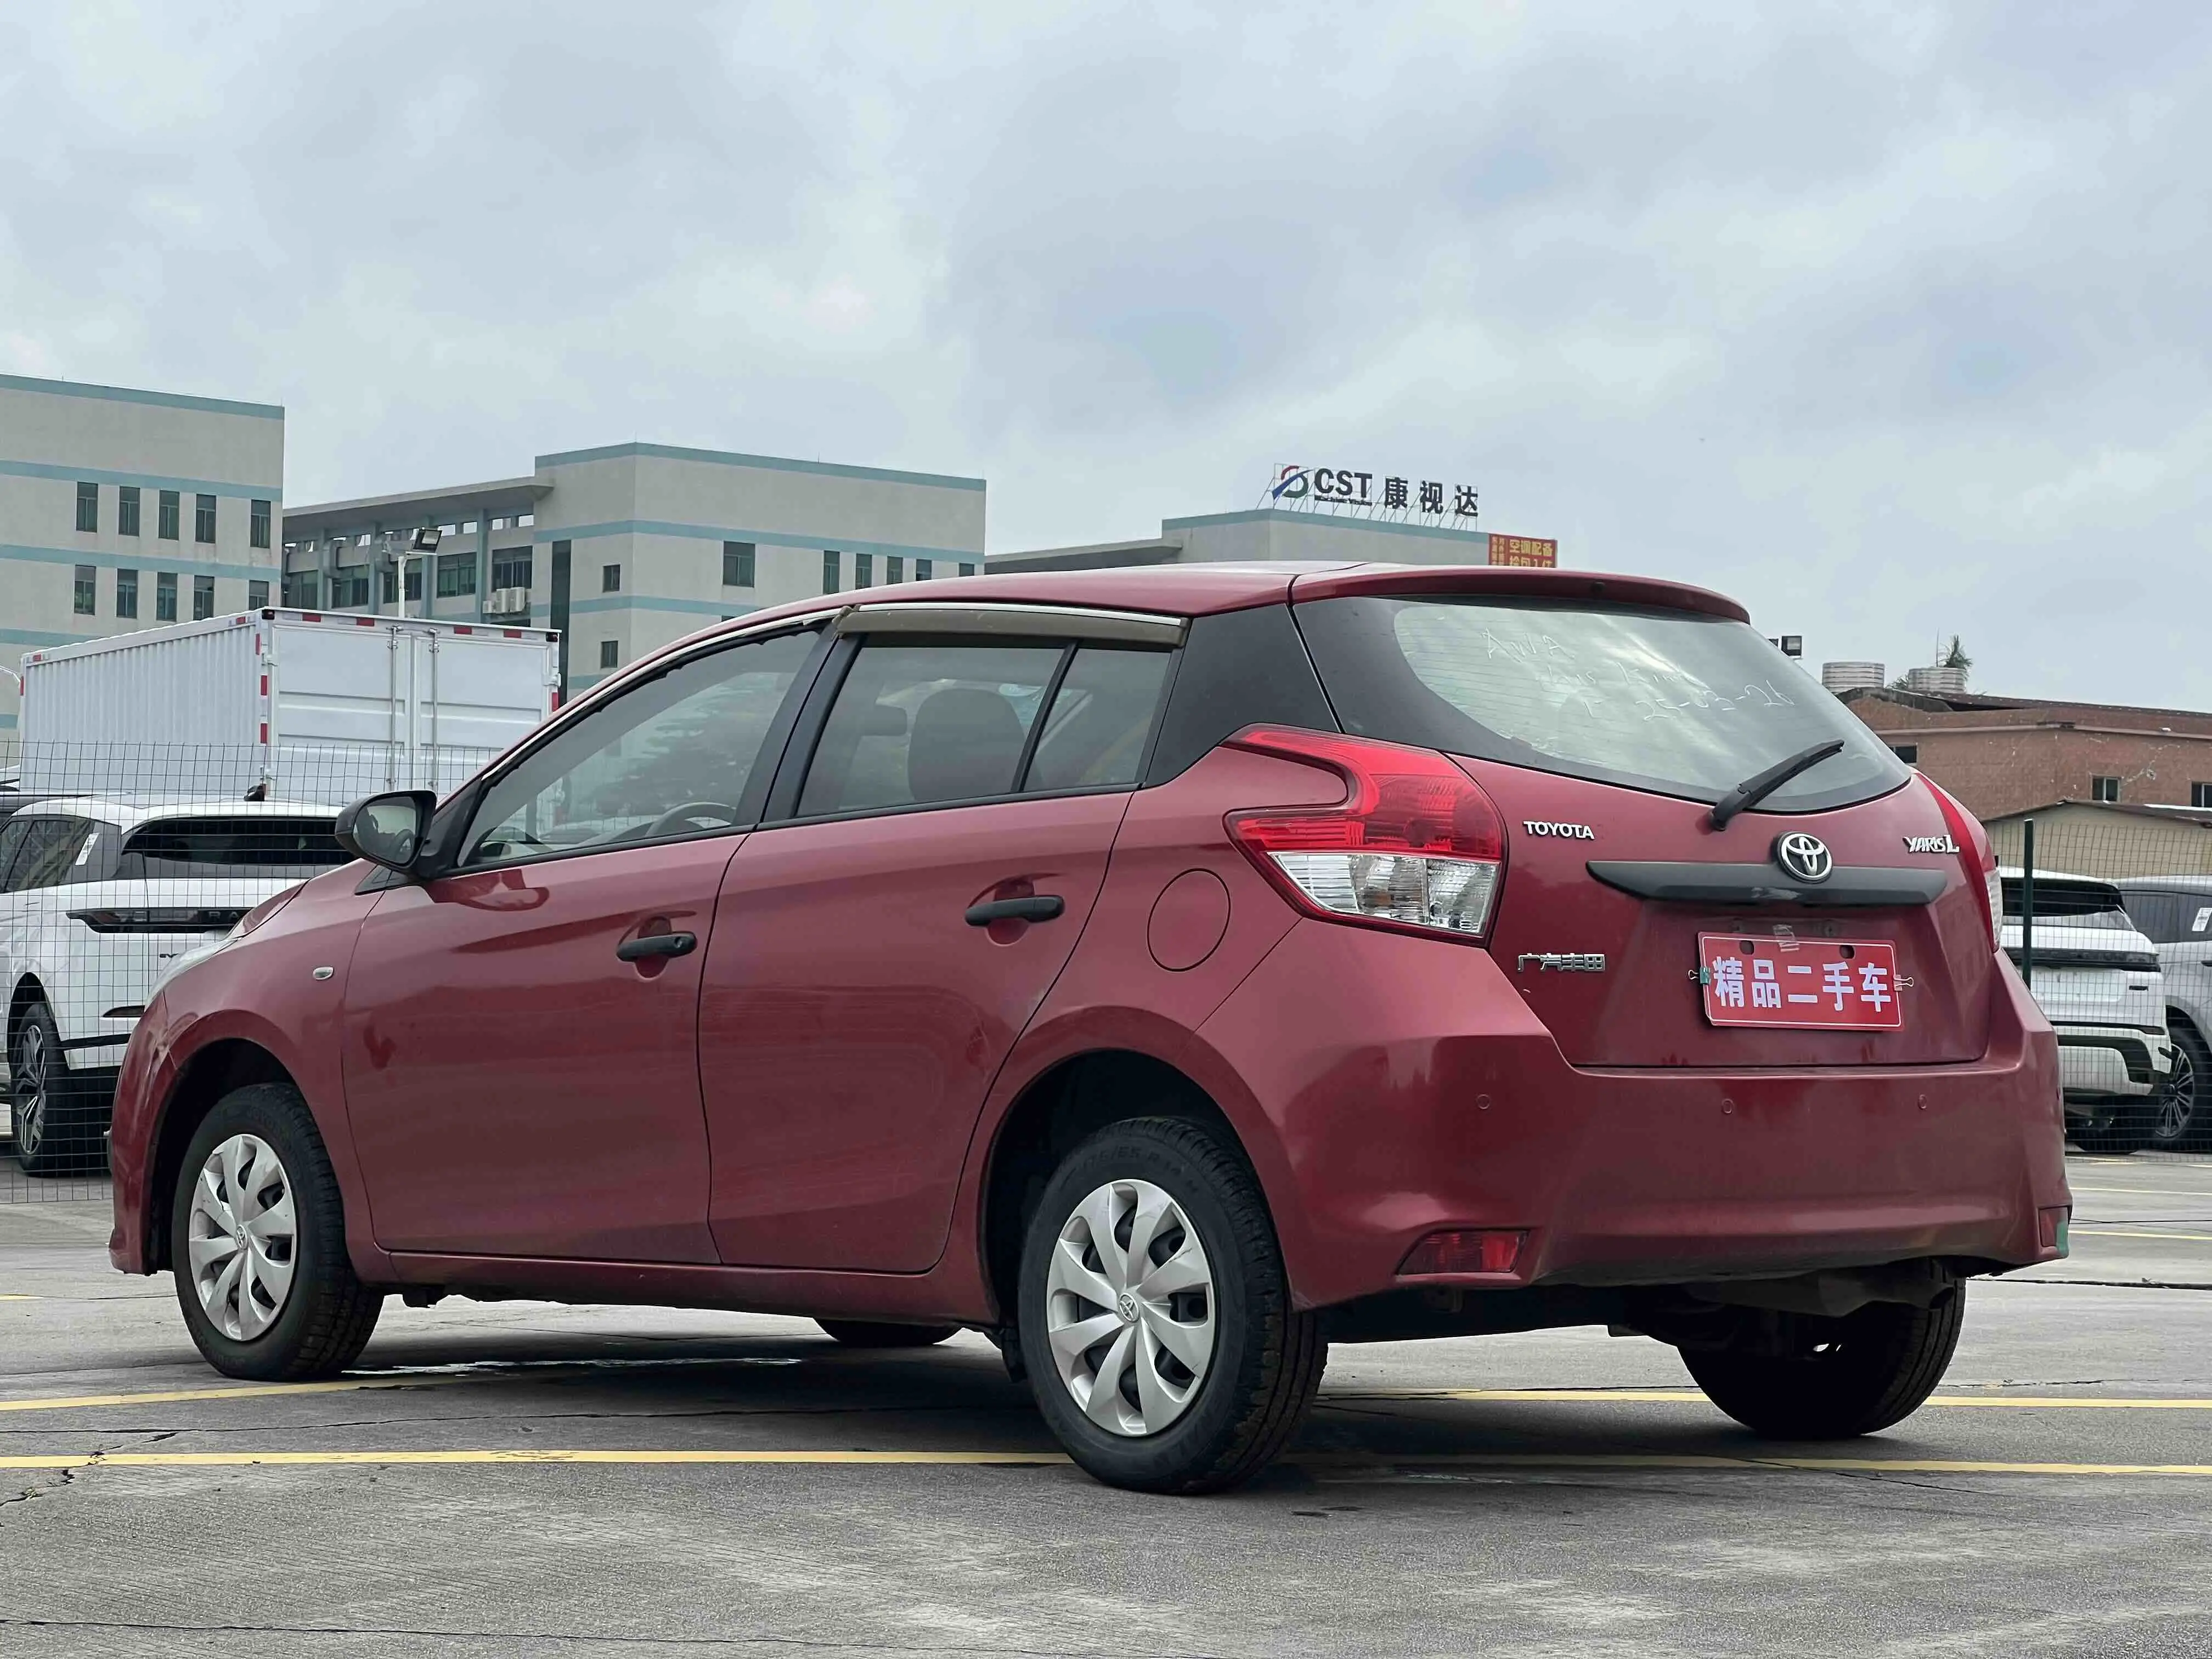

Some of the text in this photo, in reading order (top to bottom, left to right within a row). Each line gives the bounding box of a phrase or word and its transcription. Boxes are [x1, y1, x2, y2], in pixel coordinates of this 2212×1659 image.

[1314, 468, 1372, 498] CST
[1385, 477, 1479, 517] 康视达
[1523, 820, 1595, 840] TOYOTA
[1517, 952, 1606, 972] 广汽丰田
[1712, 956, 1892, 1013] 精品二手车
